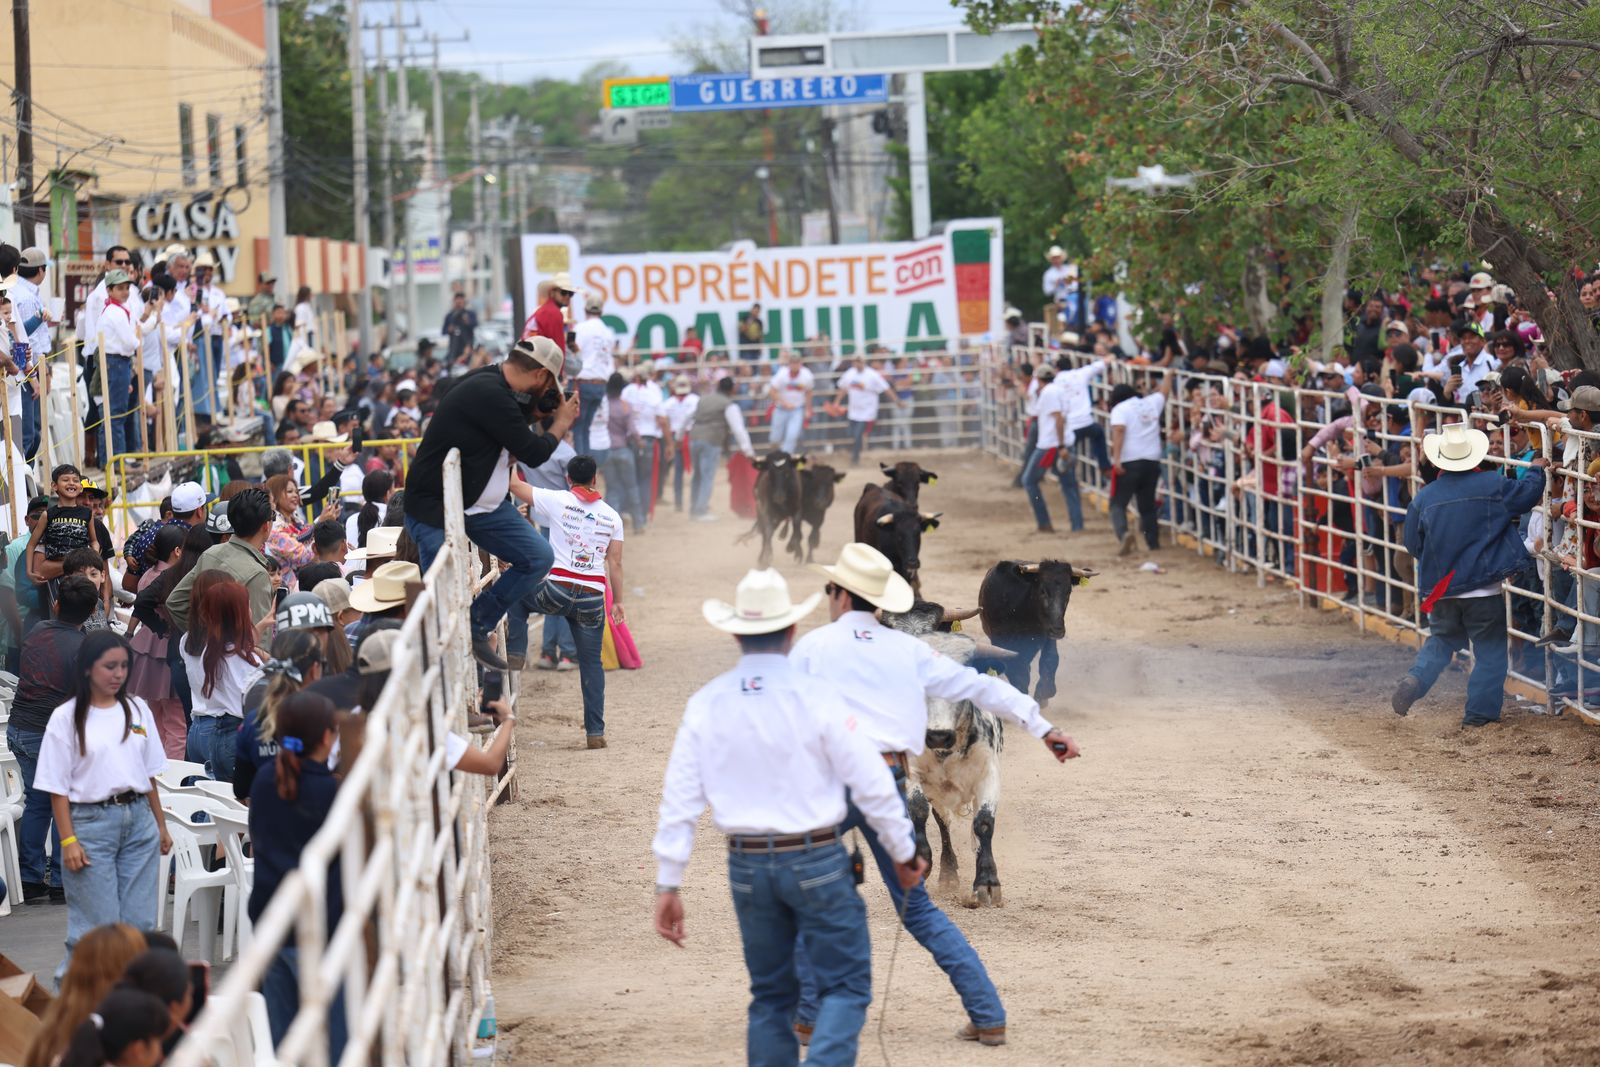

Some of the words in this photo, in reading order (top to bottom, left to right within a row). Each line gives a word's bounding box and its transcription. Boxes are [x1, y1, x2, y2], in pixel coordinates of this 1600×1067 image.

[699, 76, 857, 103] GUERRERO
[133, 200, 240, 241] CASA
[584, 252, 886, 305] SORPRÉNDETE
[896, 255, 942, 285] con
[289, 603, 327, 626] PM
